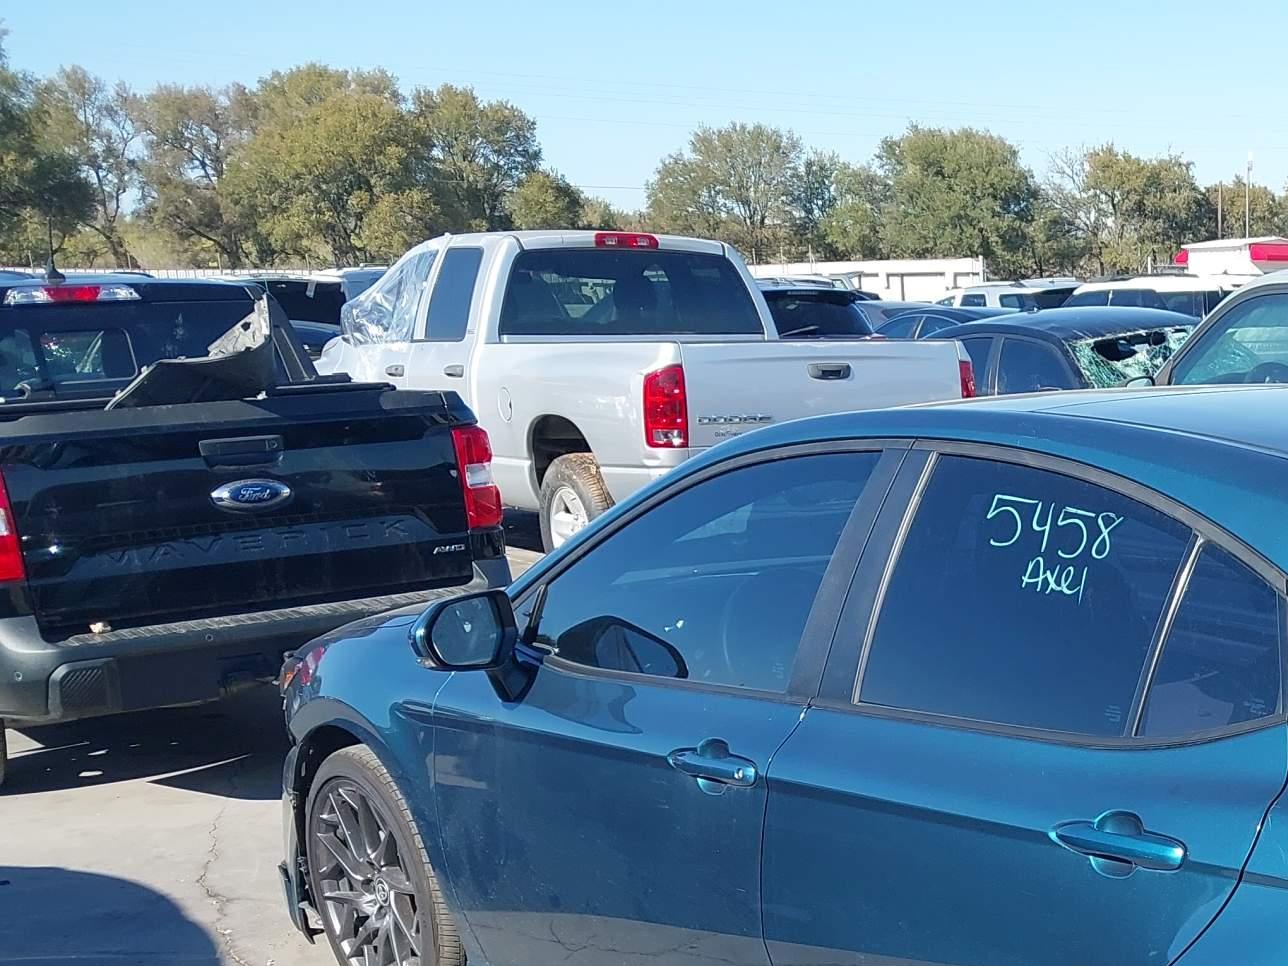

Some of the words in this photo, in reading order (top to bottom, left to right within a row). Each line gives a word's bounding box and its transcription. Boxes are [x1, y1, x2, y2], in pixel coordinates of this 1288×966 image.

[697, 414, 773, 425] DODGE
[238, 486, 271, 500] Ford
[986, 494, 1124, 560] 5458
[101, 519, 409, 567] MAVERICK
[432, 543, 466, 555] AWD
[1021, 556, 1088, 605] Axel
